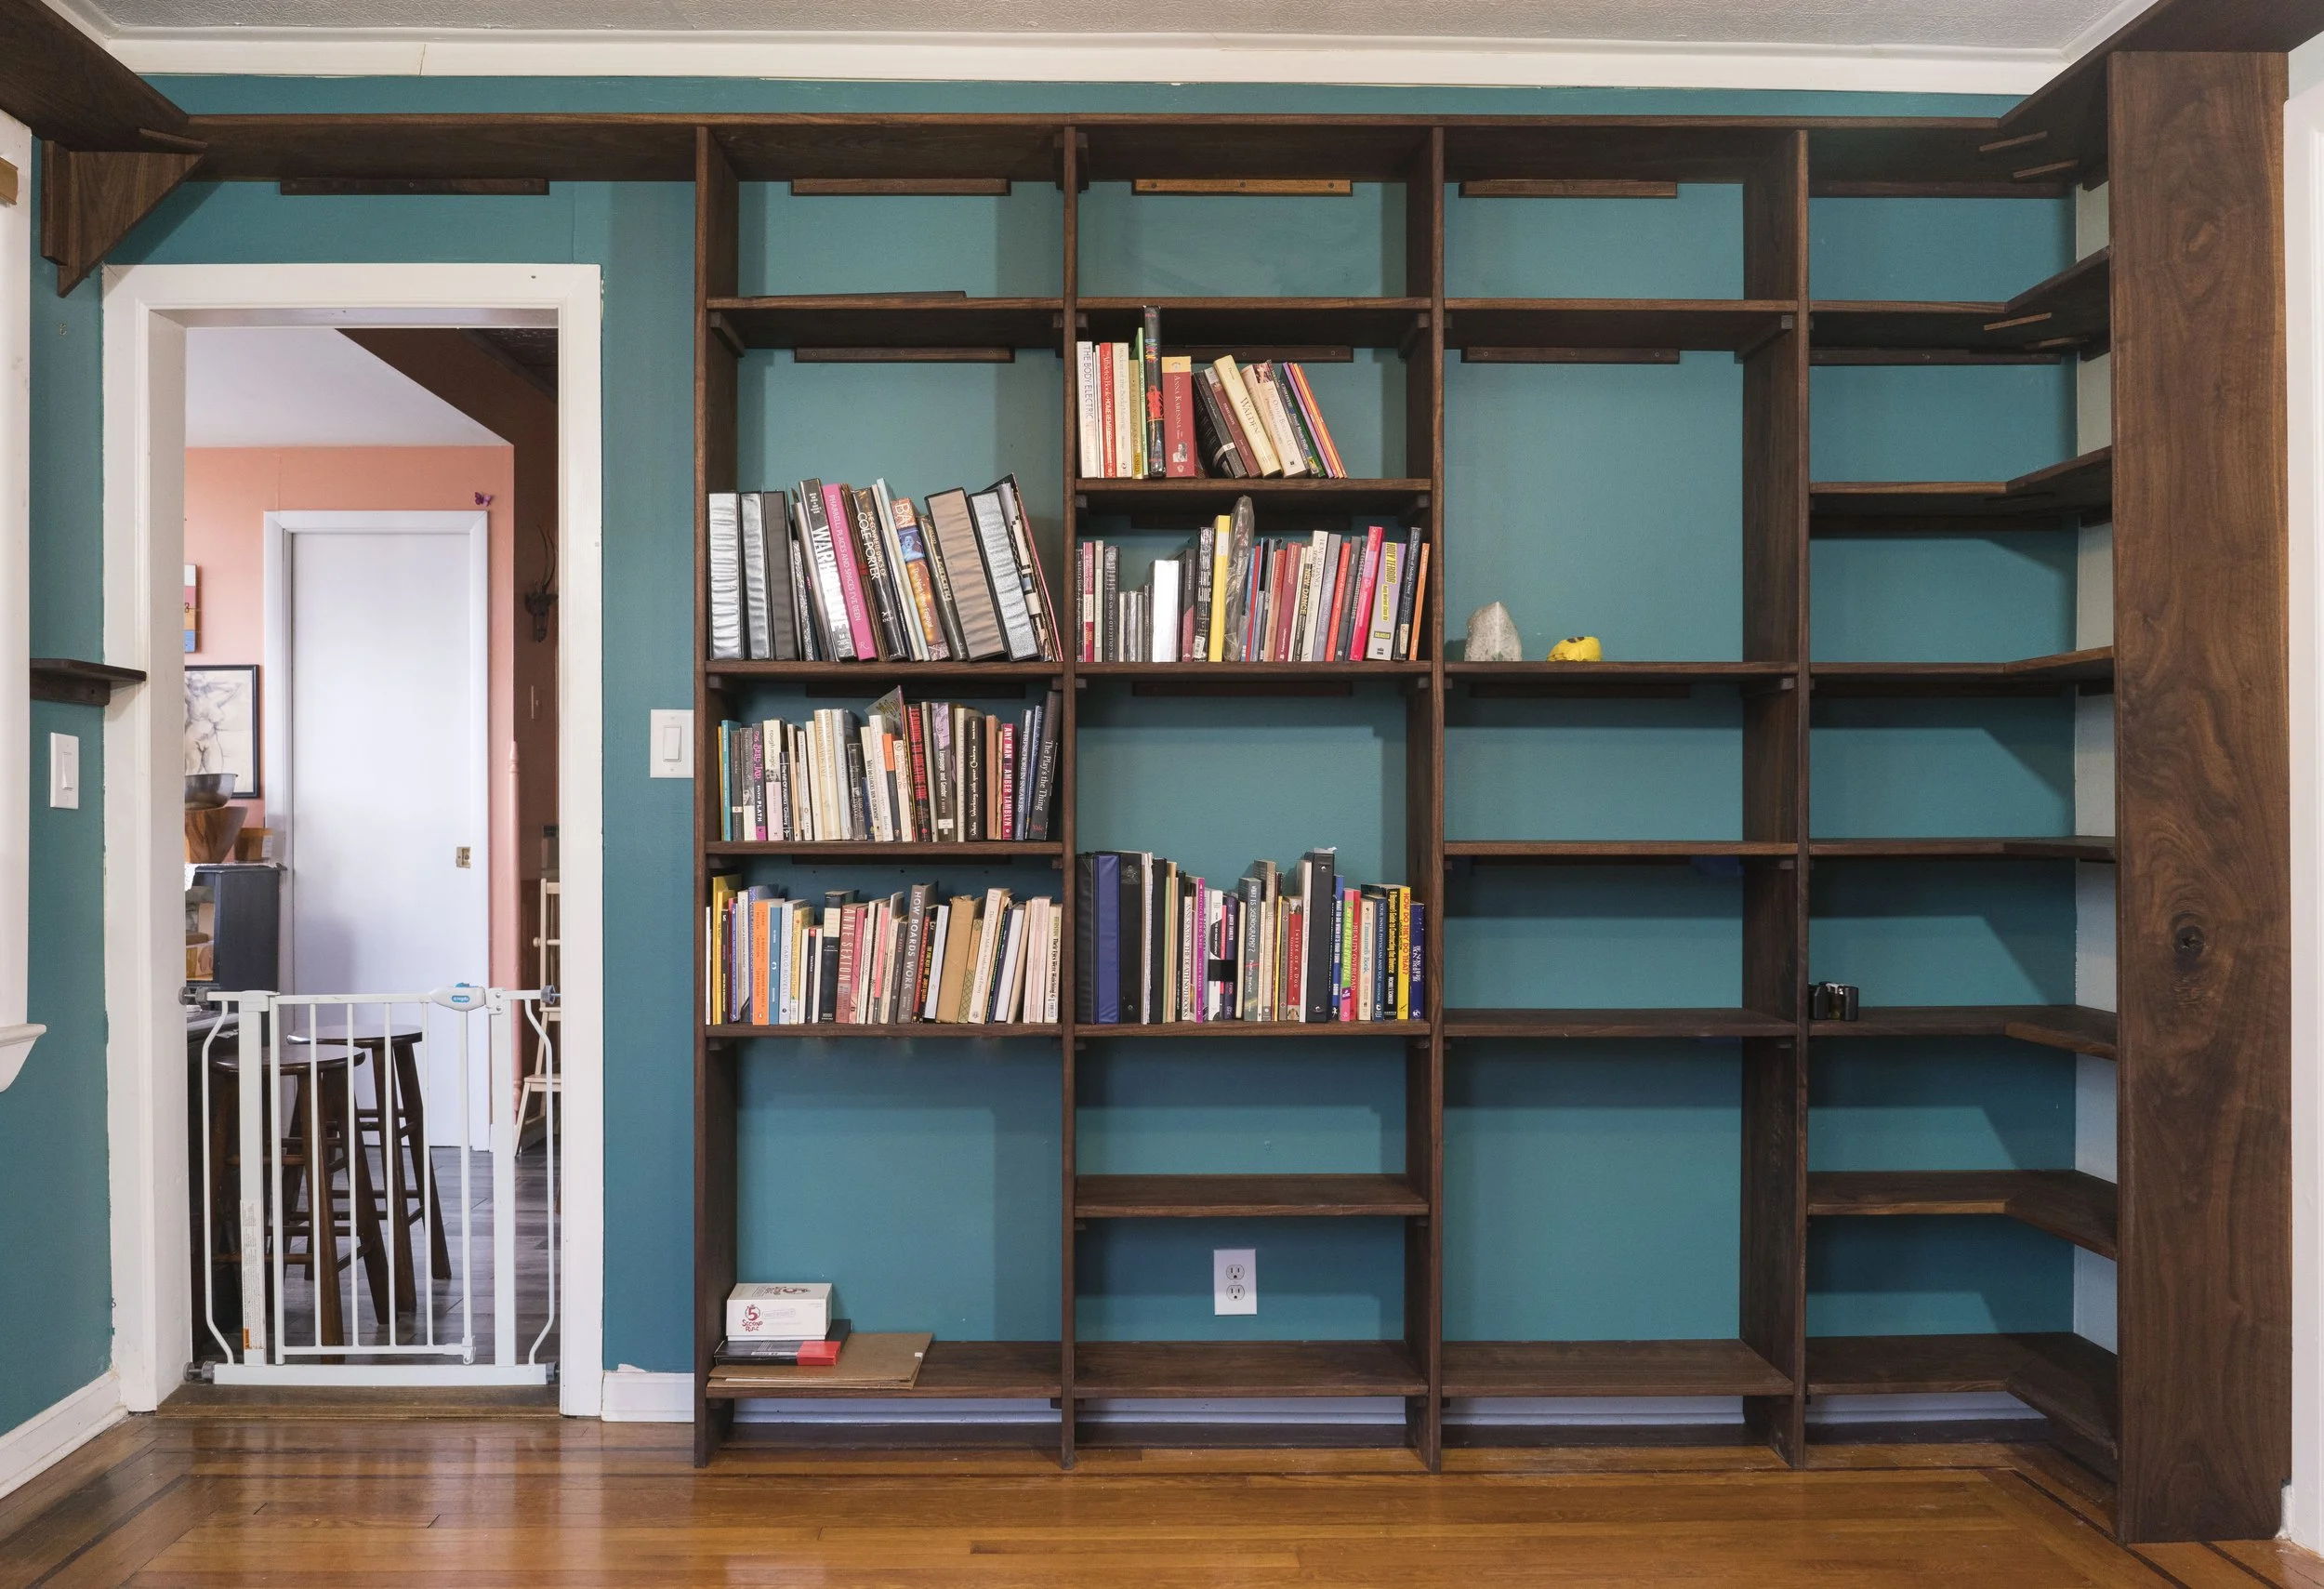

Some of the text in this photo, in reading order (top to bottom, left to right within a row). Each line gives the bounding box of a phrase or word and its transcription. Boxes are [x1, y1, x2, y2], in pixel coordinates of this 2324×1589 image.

[1083, 346, 1093, 418] THE BODY ELECTRIC
[1173, 375, 1182, 394] ANNA
[1118, 391, 1127, 407] Body
[1222, 403, 1235, 425] PERSUASION
[1240, 397, 1259, 434] WALDEN
[837, 529, 847, 552] PLACES
[857, 511, 880, 580] COLE PORTER
[840, 553, 850, 568] AND
[1386, 544, 1396, 583] HOLY TERROR
[845, 569, 854, 591] SPACES
[850, 591, 858, 604] I'VE
[1300, 589, 1309, 615] DANCE
[1352, 573, 1364, 620] Communities
[852, 604, 862, 621] BEEN
[922, 608, 933, 629] Festival
[909, 708, 922, 743] LEARNING
[912, 744, 923, 753] TO
[970, 746, 978, 768] Chakras
[1004, 743, 1012, 759] MAN
[913, 754, 925, 785] BREATHE
[1035, 740, 1053, 811] The Play's the Thing
[916, 786, 927, 801] FIRE
[1017, 780, 1025, 813] SNEAKERS
[870, 799, 879, 821] CLOCKWISE?
[970, 793, 978, 817] Working
[1387, 894, 1397, 912] Beginner's
[841, 908, 855, 935] ANNE
[1389, 913, 1397, 923] Guide
[1403, 912, 1409, 923] DO
[904, 891, 922, 990] HOW BOARDS WORK
[1247, 907, 1256, 953] SCENOGRAPHY?
[1387, 928, 1396, 951] Constructing
[1295, 955, 1299, 963] OF
[1403, 943, 1408, 953] DO
[838, 942, 853, 982] SEXTON
[748, 1305, 758, 1321] 5
